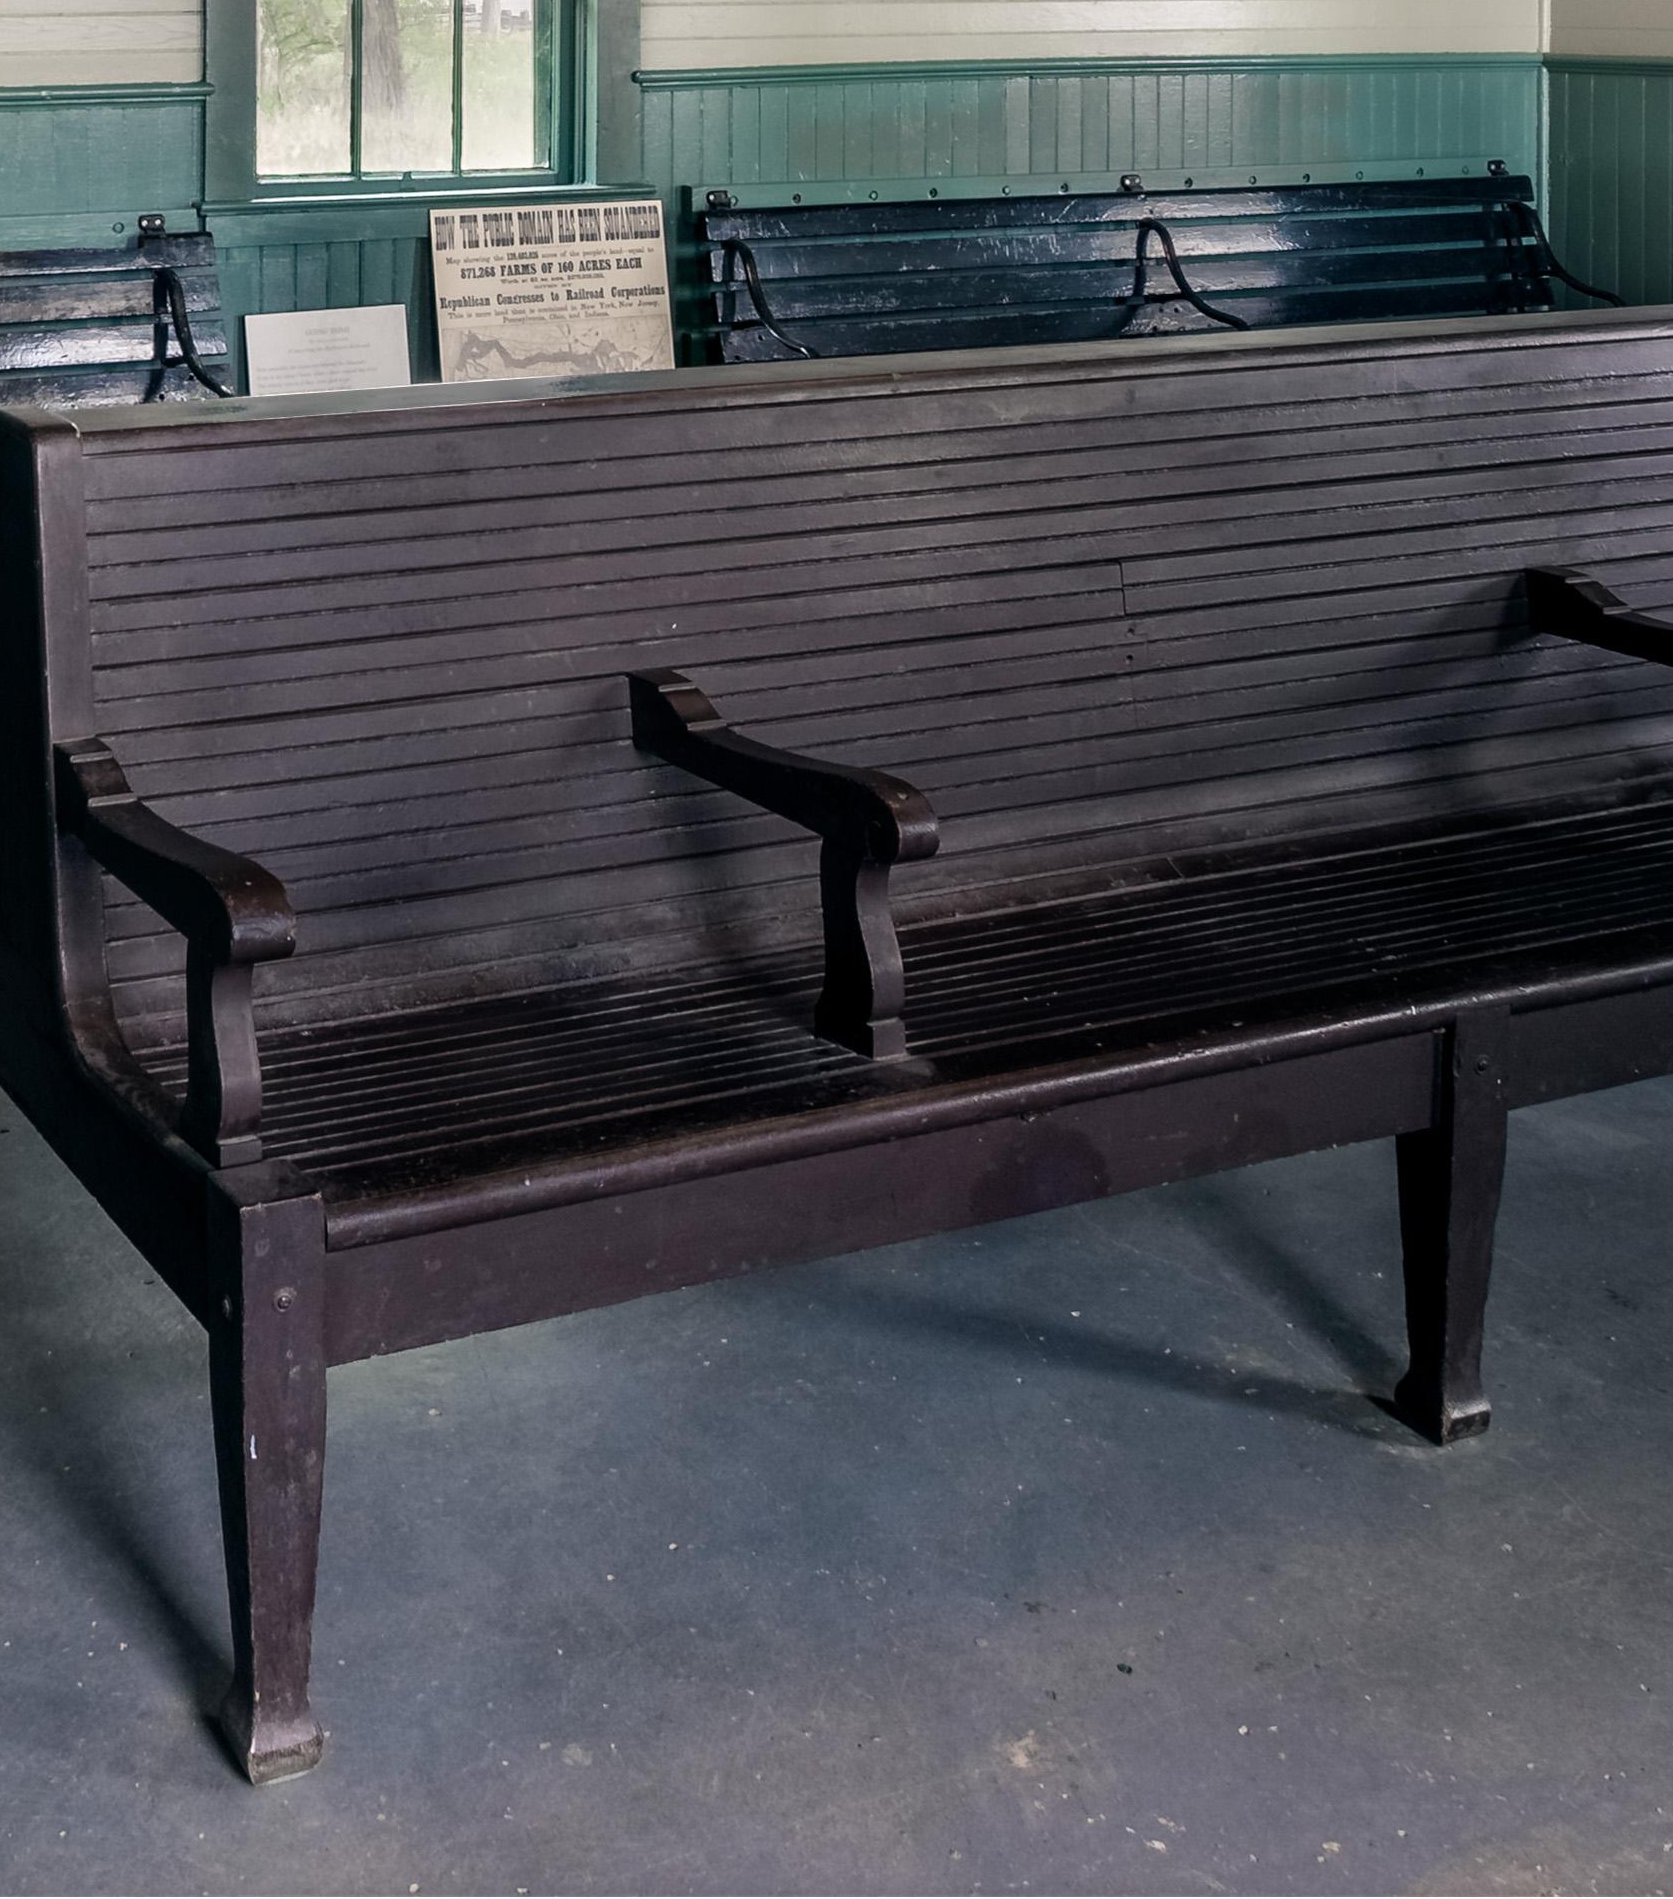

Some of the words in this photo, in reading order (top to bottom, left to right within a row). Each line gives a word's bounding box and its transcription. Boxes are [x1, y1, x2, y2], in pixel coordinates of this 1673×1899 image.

[434, 215, 455, 251] HOW
[459, 214, 479, 249] THE
[482, 212, 514, 247] PUBLIC
[517, 209, 554, 245] DOMAIN
[557, 209, 576, 243] HAS
[578, 207, 601, 242] BEEN
[603, 205, 660, 241] SQUANDERED
[460, 266, 496, 279] 871,268
[500, 263, 537, 276] FARMS
[541, 262, 553, 273] OF
[558, 261, 574, 273] 160
[578, 259, 611, 272] ACRES
[616, 257, 642, 269] EACH
[439, 295, 490, 311] Republican
[496, 292, 545, 305] Congresses
[550, 291, 559, 301] to
[566, 287, 604, 301] Railroad
[611, 284, 665, 300] Corporations
